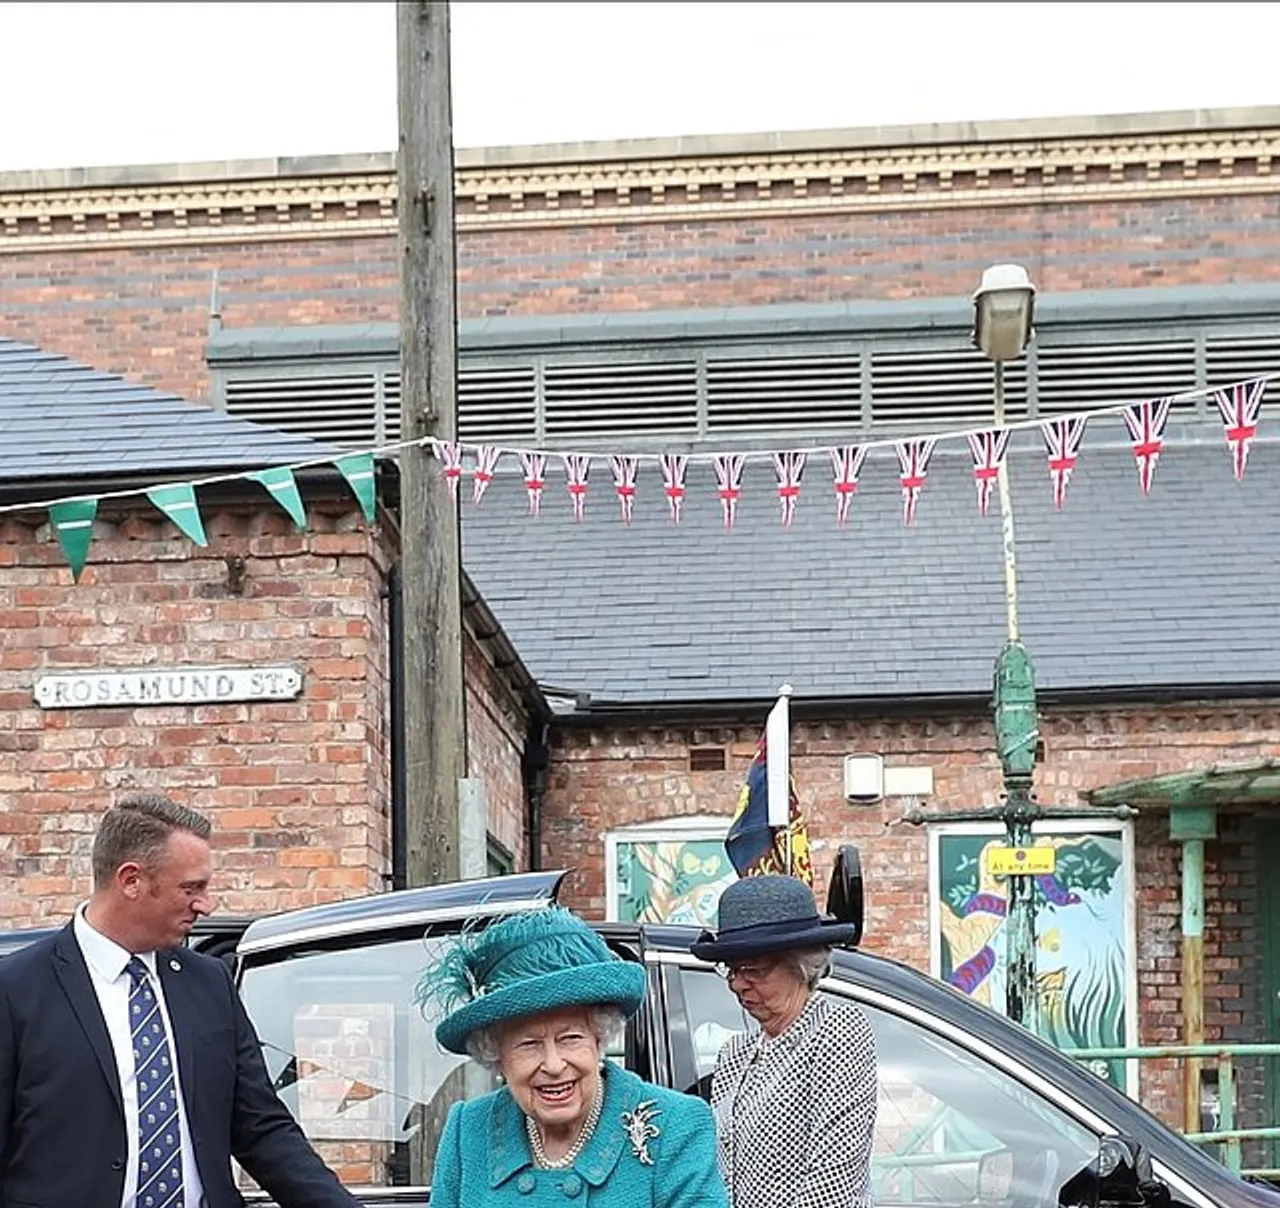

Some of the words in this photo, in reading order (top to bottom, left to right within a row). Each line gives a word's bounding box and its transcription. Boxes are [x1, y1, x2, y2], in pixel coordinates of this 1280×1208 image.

[53, 674, 235, 704] ROSAMUND
[250, 672, 285, 696] ST.
[992, 862, 1004, 871] At
